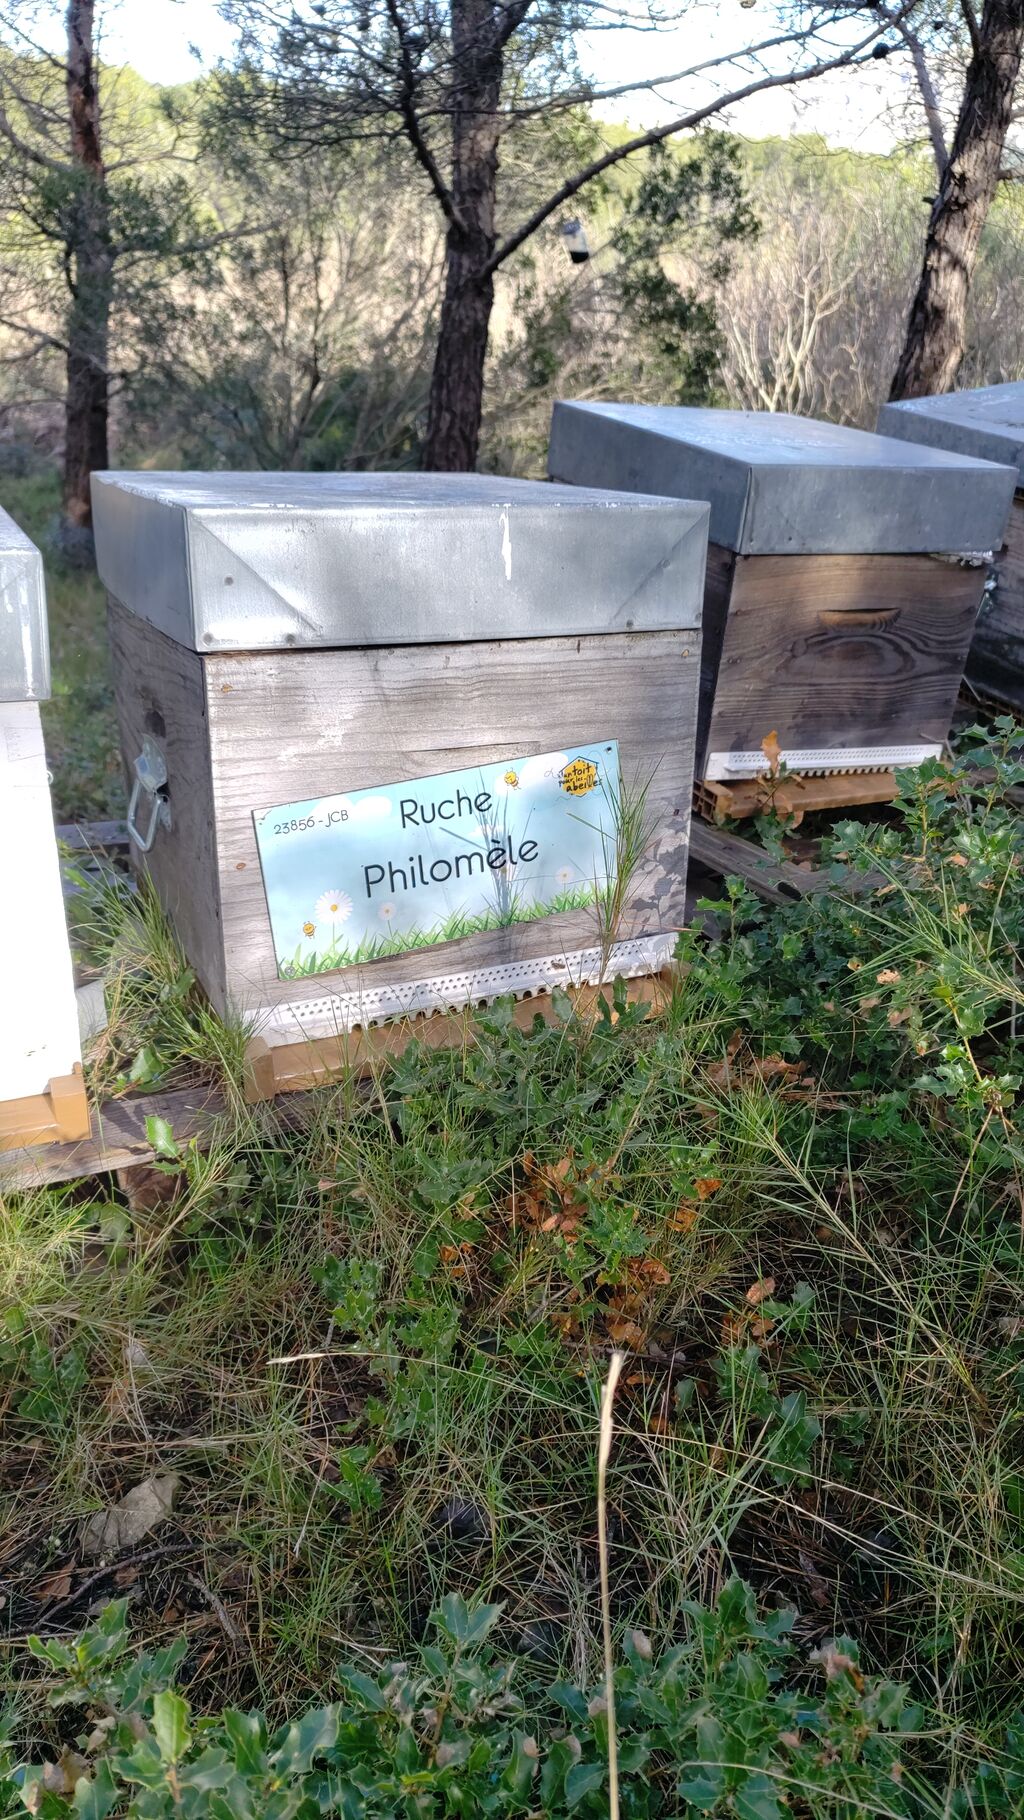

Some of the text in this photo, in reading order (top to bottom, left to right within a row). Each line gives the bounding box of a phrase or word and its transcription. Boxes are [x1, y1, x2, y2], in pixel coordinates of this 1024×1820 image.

[572, 763, 592, 776] toit
[566, 774, 602, 792] abeilles
[273, 815, 315, 835] 23856
[325, 809, 349, 828] JCB
[400, 789, 492, 829] Ruche
[364, 834, 539, 898] Philomèle
